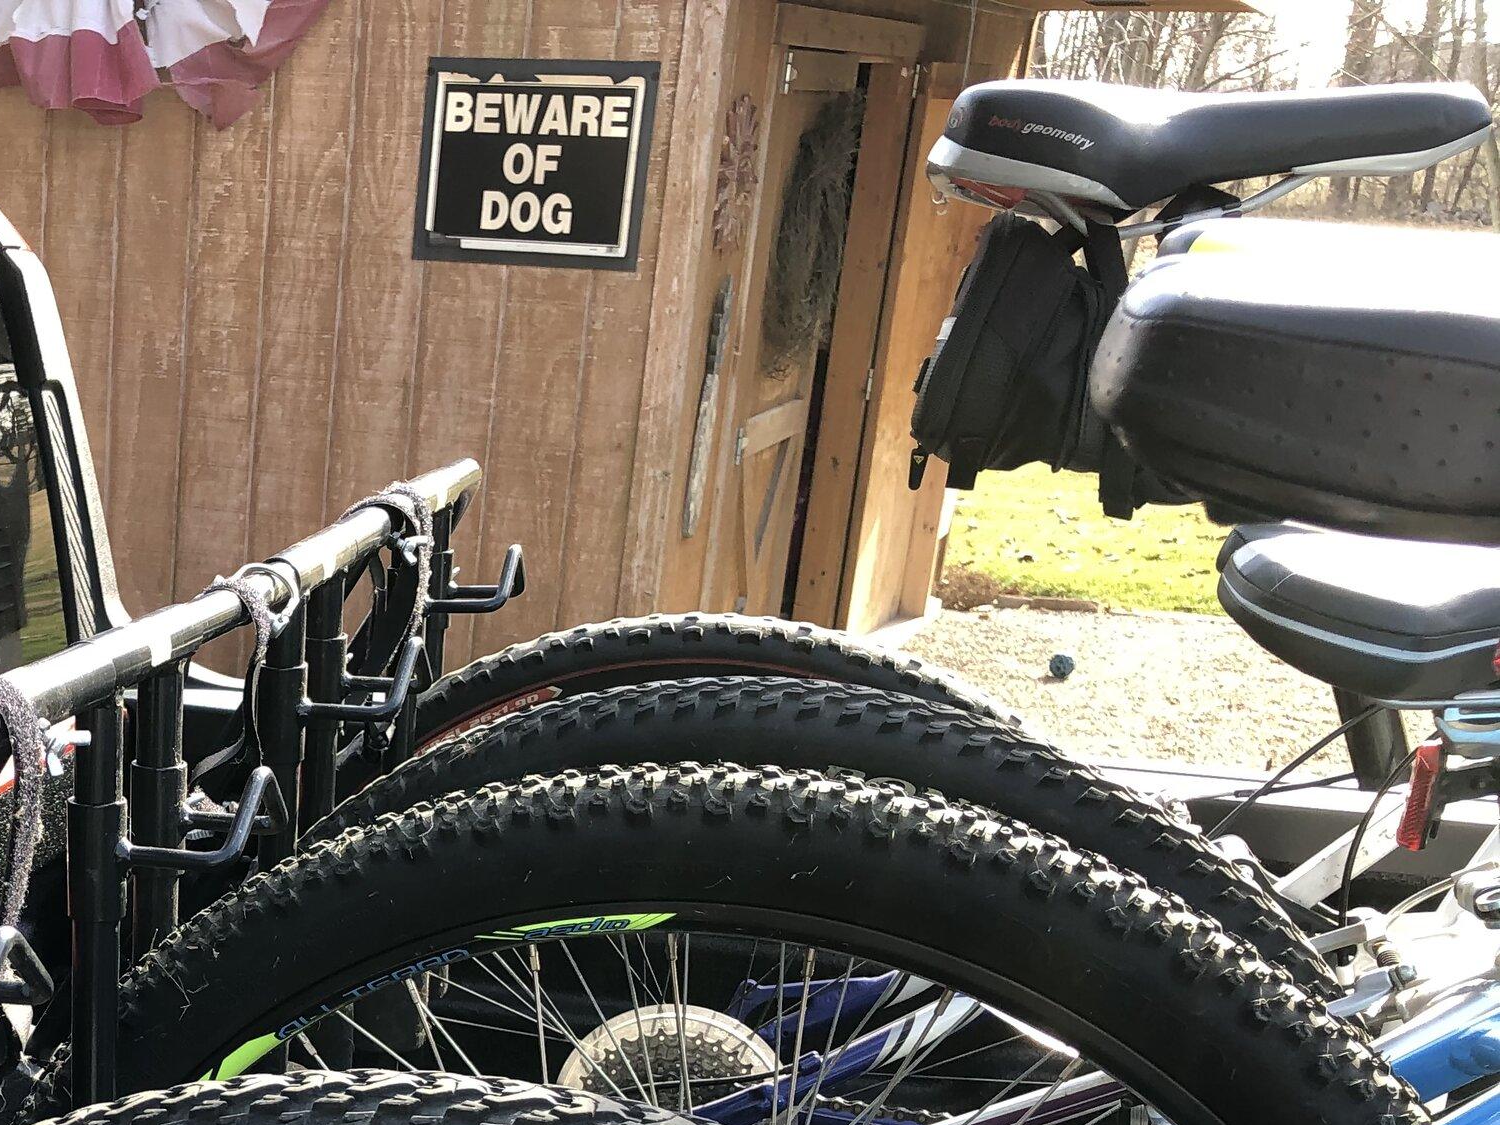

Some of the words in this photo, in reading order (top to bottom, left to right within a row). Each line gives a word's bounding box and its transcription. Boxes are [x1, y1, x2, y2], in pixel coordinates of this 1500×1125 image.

[444, 91, 632, 137] BEWARE
[502, 142, 563, 185] OF
[479, 190, 573, 235] DOG
